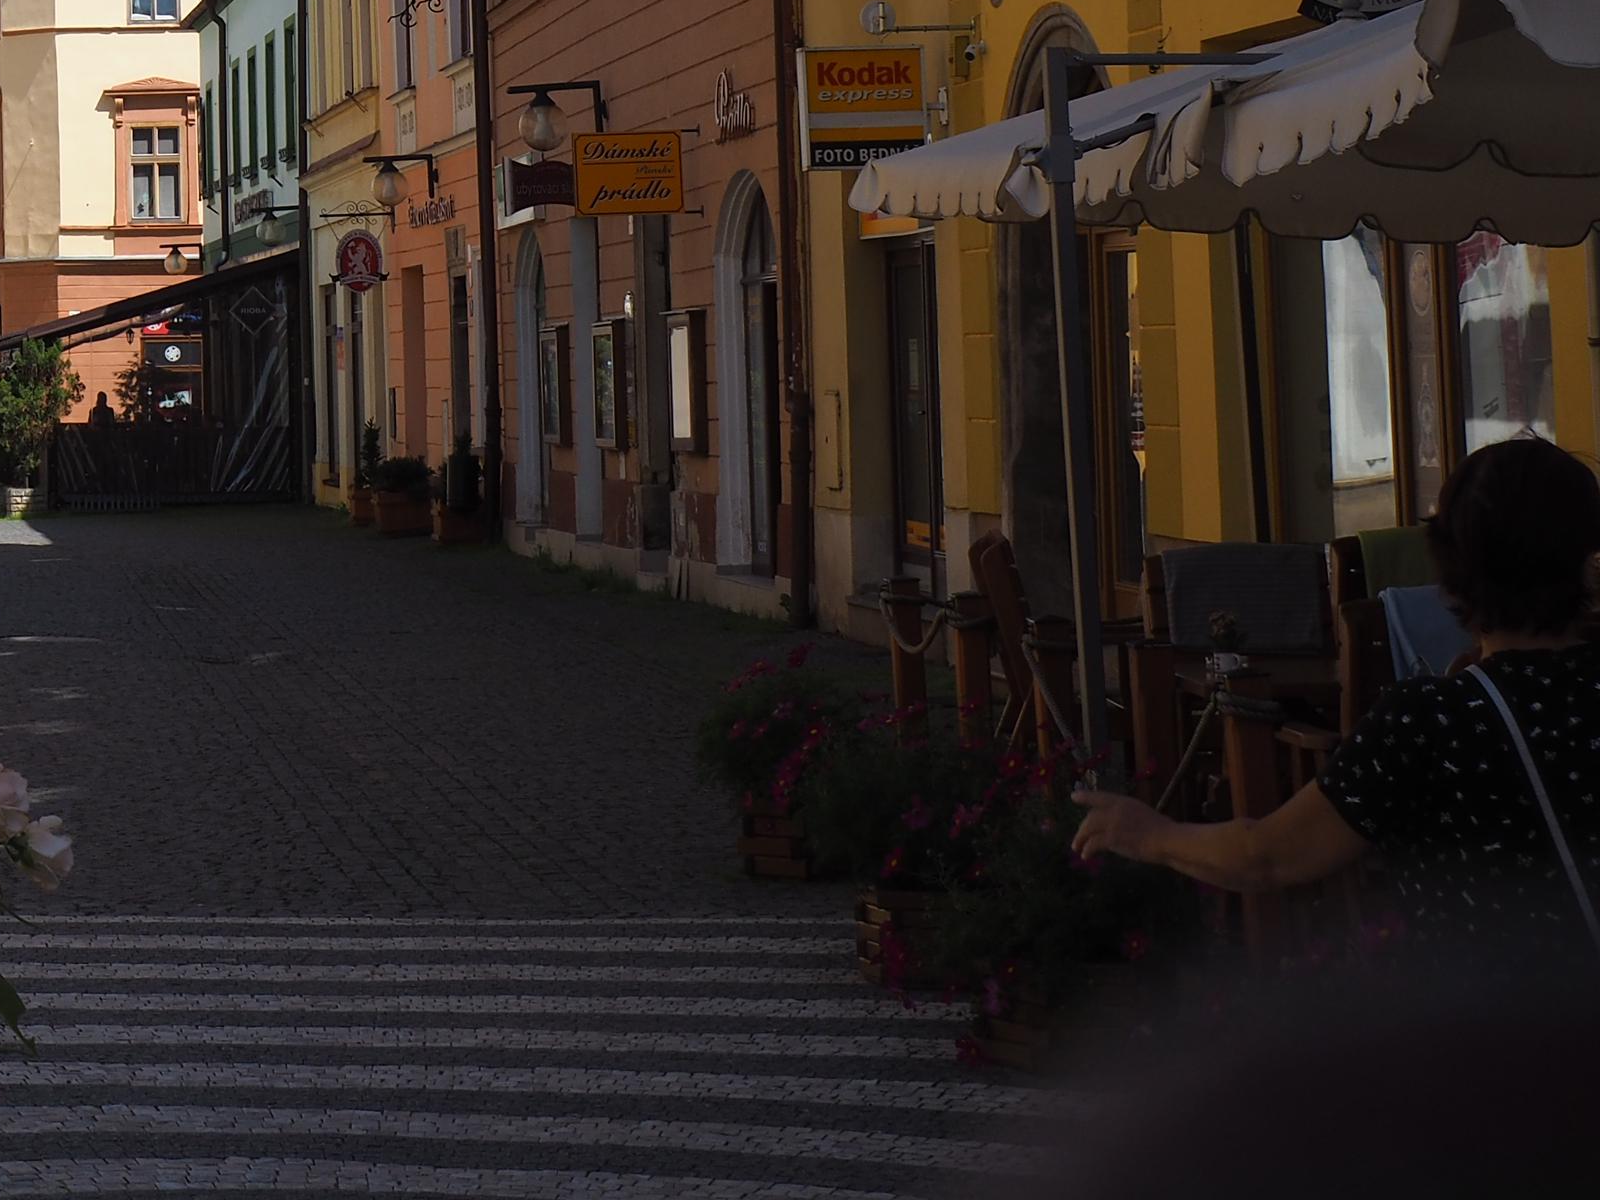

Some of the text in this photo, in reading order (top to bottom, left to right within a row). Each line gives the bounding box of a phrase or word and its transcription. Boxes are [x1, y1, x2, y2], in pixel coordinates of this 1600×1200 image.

[817, 61, 912, 86] Kodak
[818, 87, 913, 103] express
[583, 140, 673, 160] Dámské
[815, 149, 854, 163] FOTO
[590, 180, 672, 208] prádlo
